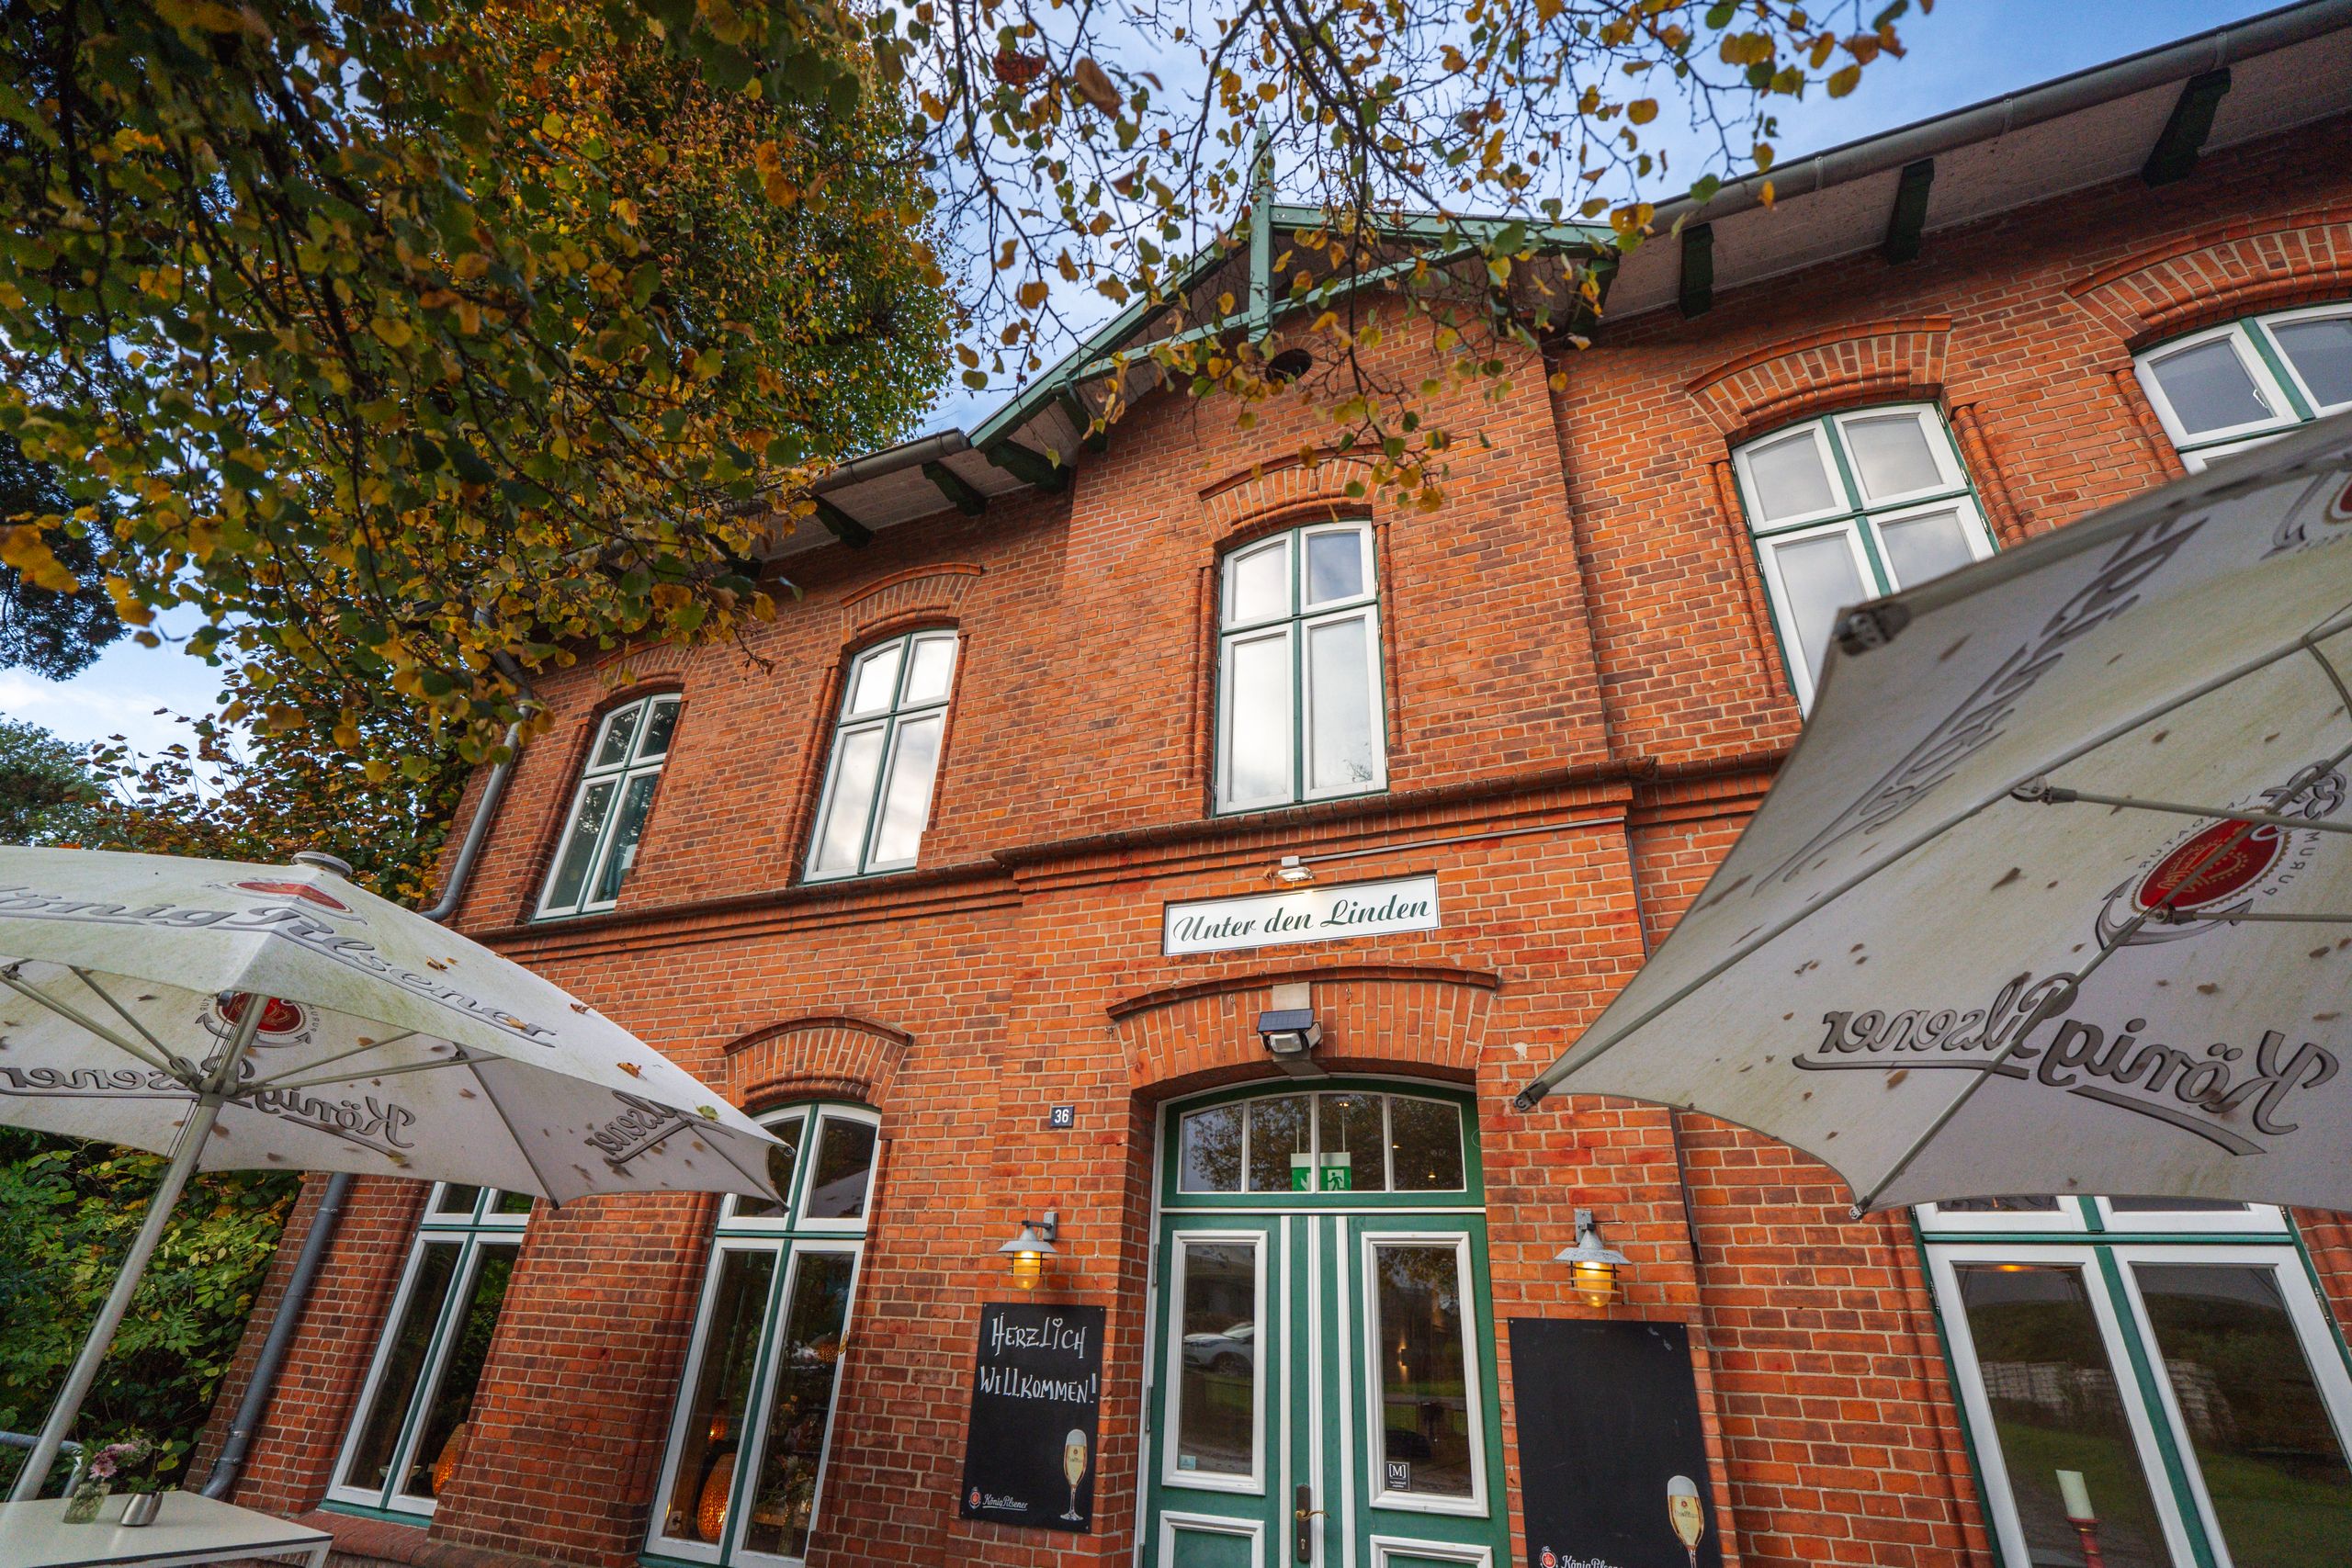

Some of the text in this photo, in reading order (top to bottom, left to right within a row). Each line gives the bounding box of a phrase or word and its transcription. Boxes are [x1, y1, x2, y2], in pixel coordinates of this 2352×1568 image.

[1172, 894, 1431, 942] Unter den Linden
[1054, 1109, 1069, 1123] 36
[979, 1365, 1097, 1404] WILLKOMMEN!
